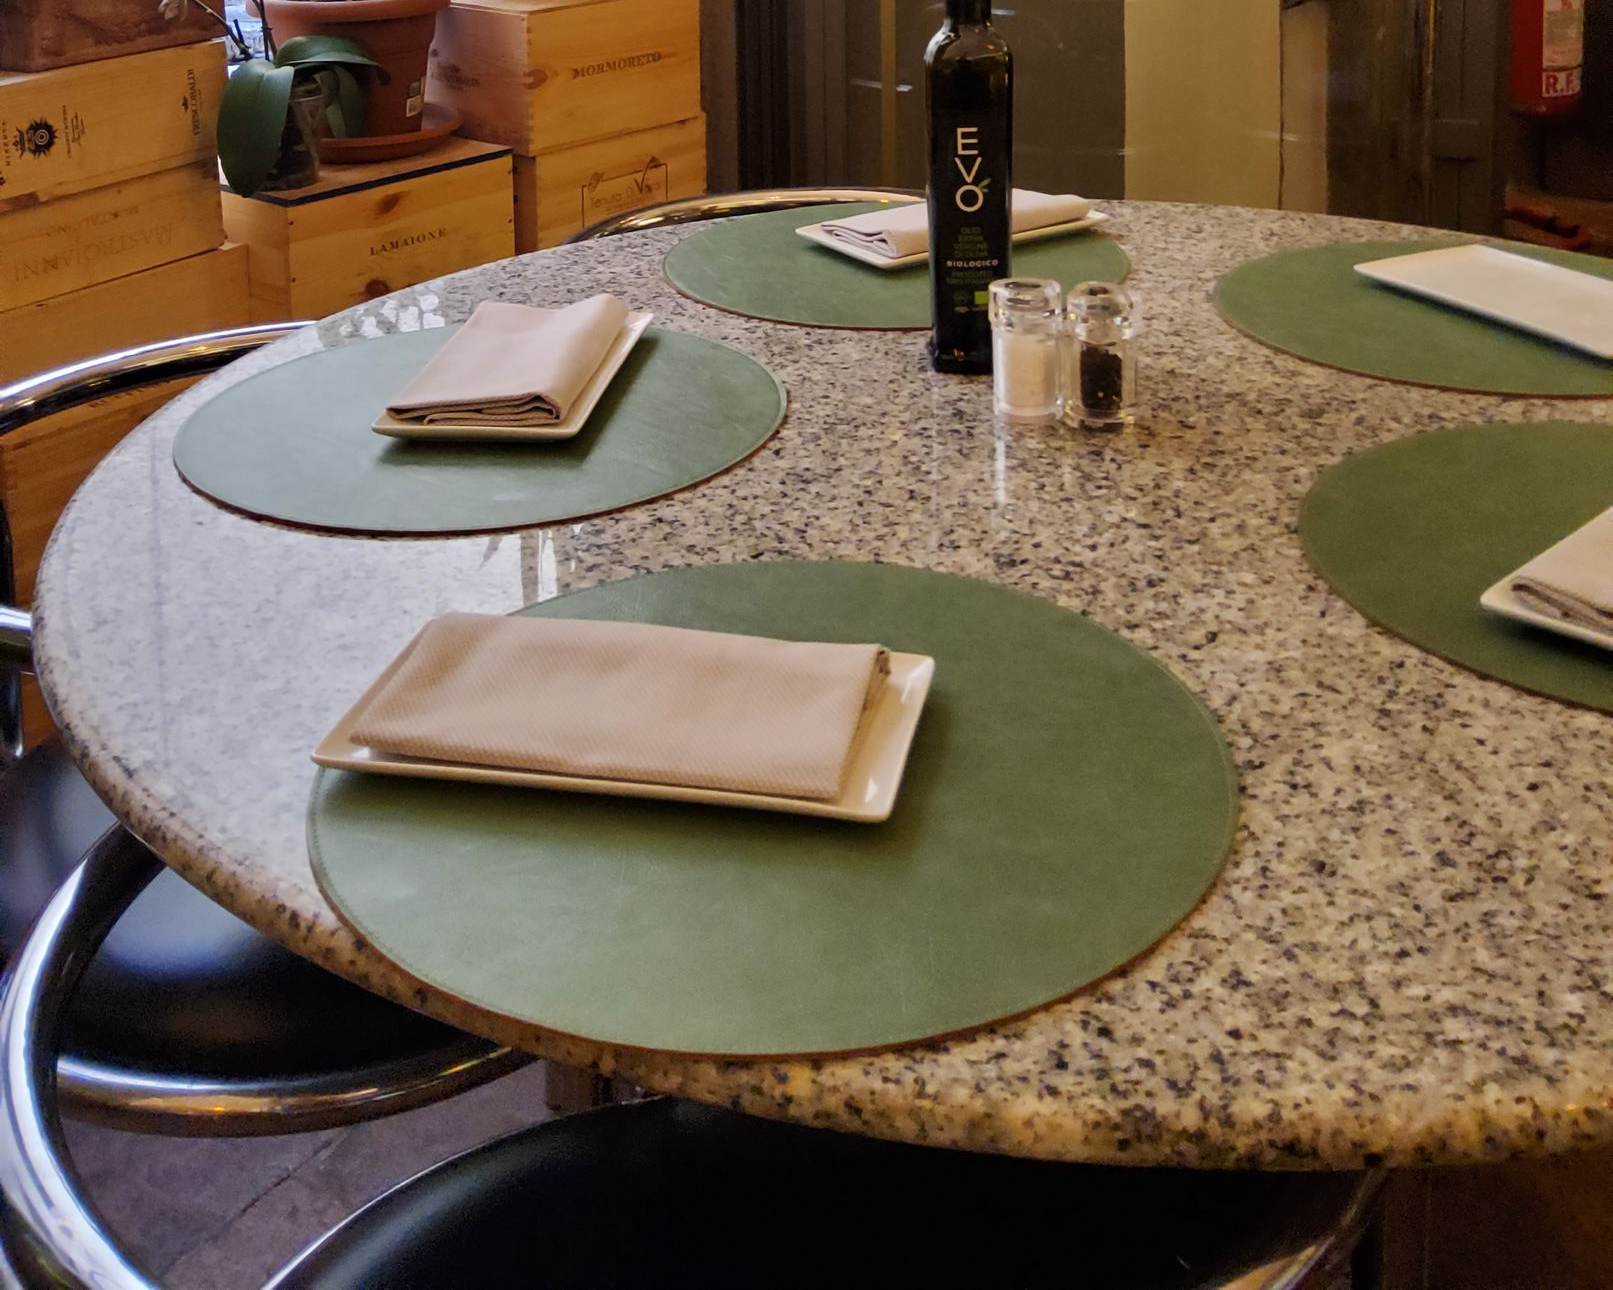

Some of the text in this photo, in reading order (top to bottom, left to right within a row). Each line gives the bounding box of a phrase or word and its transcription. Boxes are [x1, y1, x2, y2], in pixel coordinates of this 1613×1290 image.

[571, 52, 662, 79] MORMORETO
[954, 126, 983, 212] EVO
[946, 259, 999, 268] BIOLOGICO
